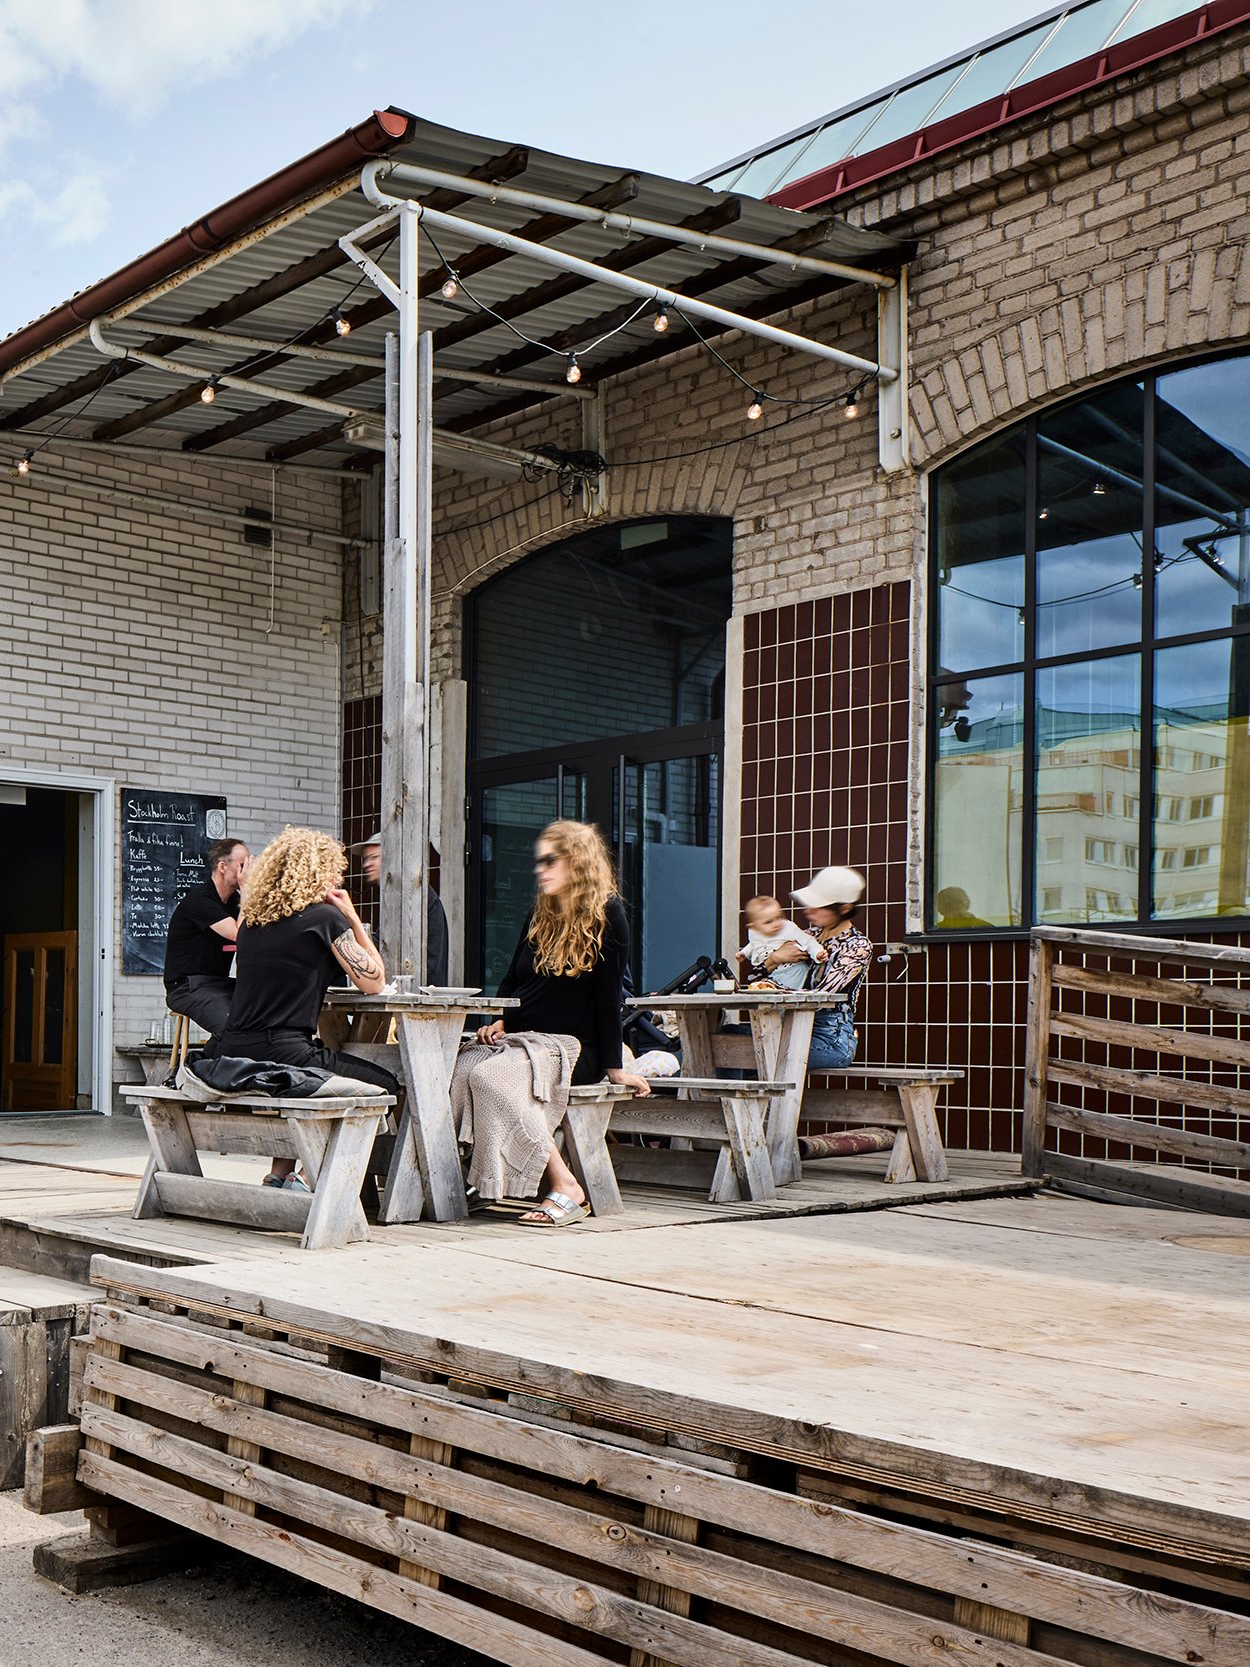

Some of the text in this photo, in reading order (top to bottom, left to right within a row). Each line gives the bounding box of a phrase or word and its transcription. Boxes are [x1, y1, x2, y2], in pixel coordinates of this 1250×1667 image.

[127, 799, 195, 822] Stockholm Roast
[180, 851, 204, 865] Lunch
